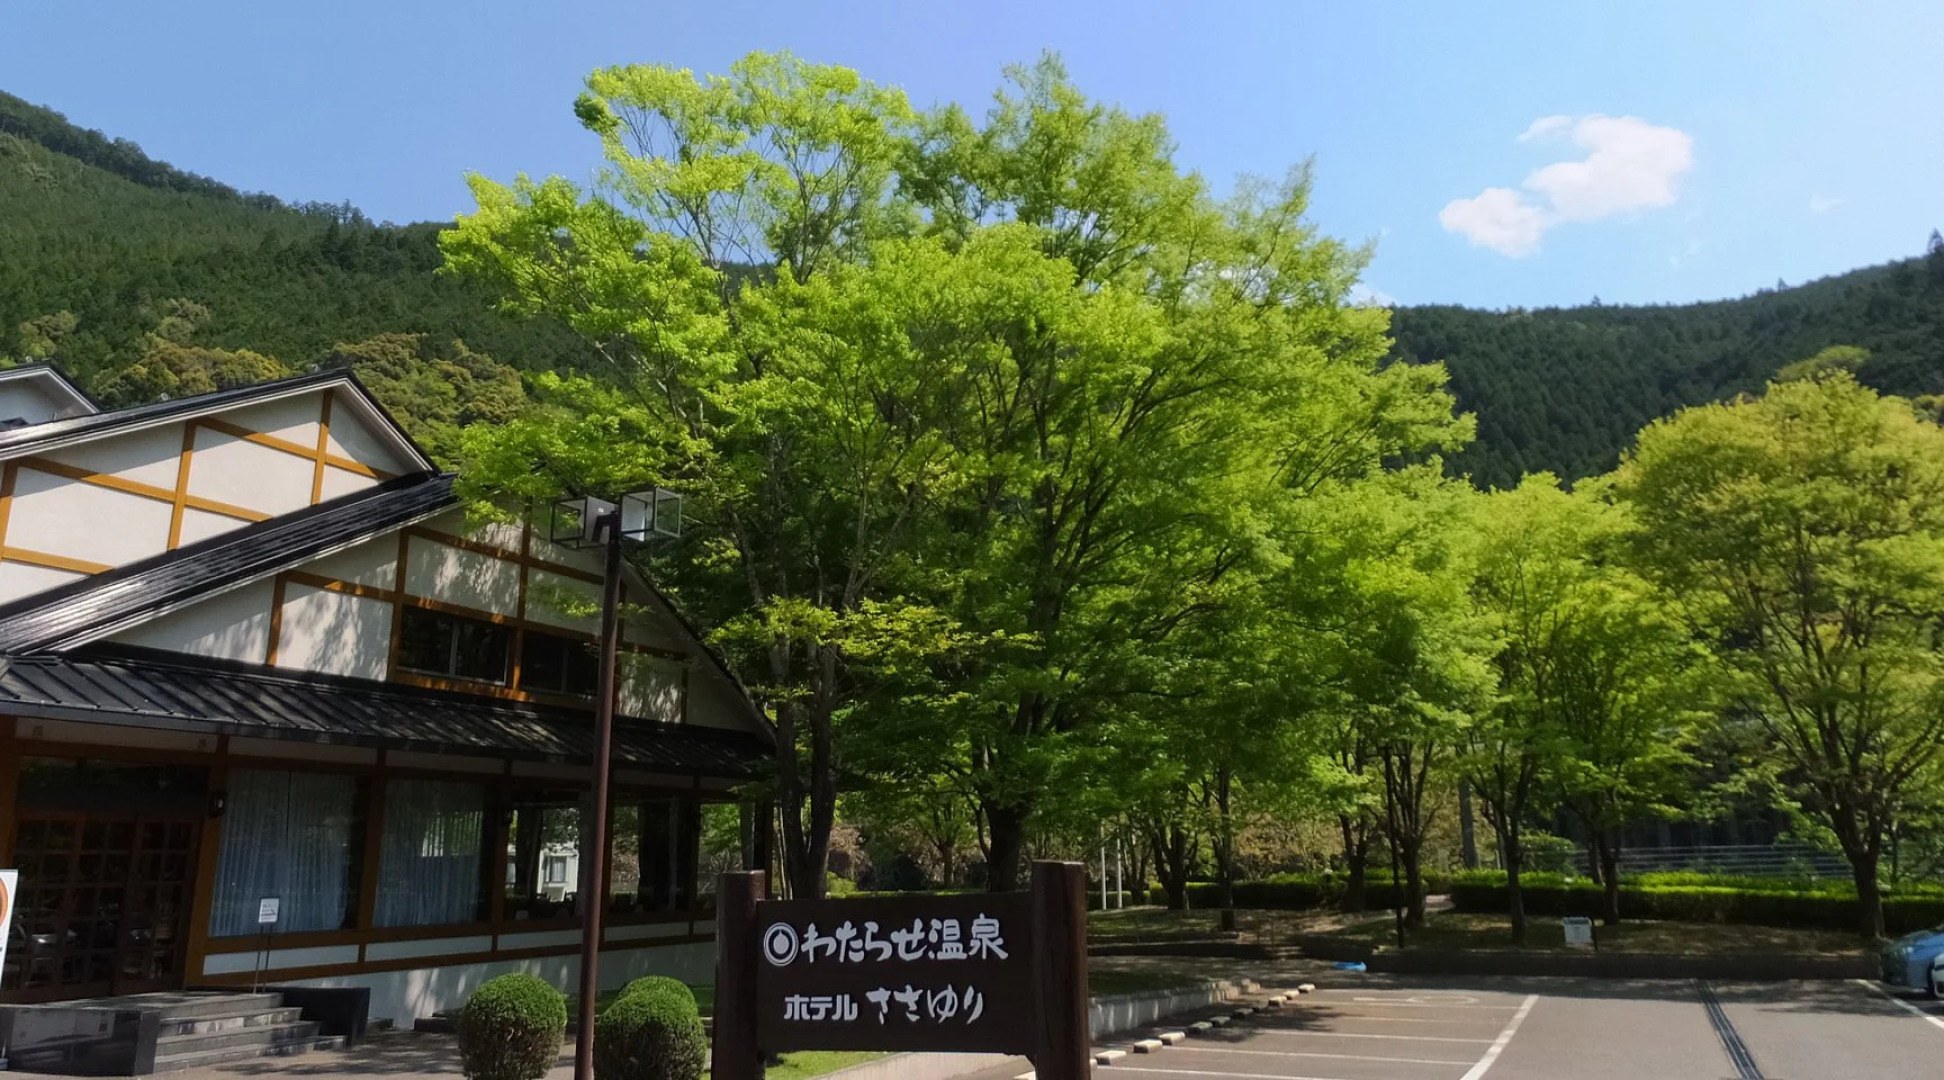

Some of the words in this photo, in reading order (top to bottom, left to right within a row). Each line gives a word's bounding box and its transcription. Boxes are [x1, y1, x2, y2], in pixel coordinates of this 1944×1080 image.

[800, 912, 1009, 964] わたらせ温泉
[783, 994, 858, 1021] ホテル
[865, 983, 984, 1025] ささゆり
